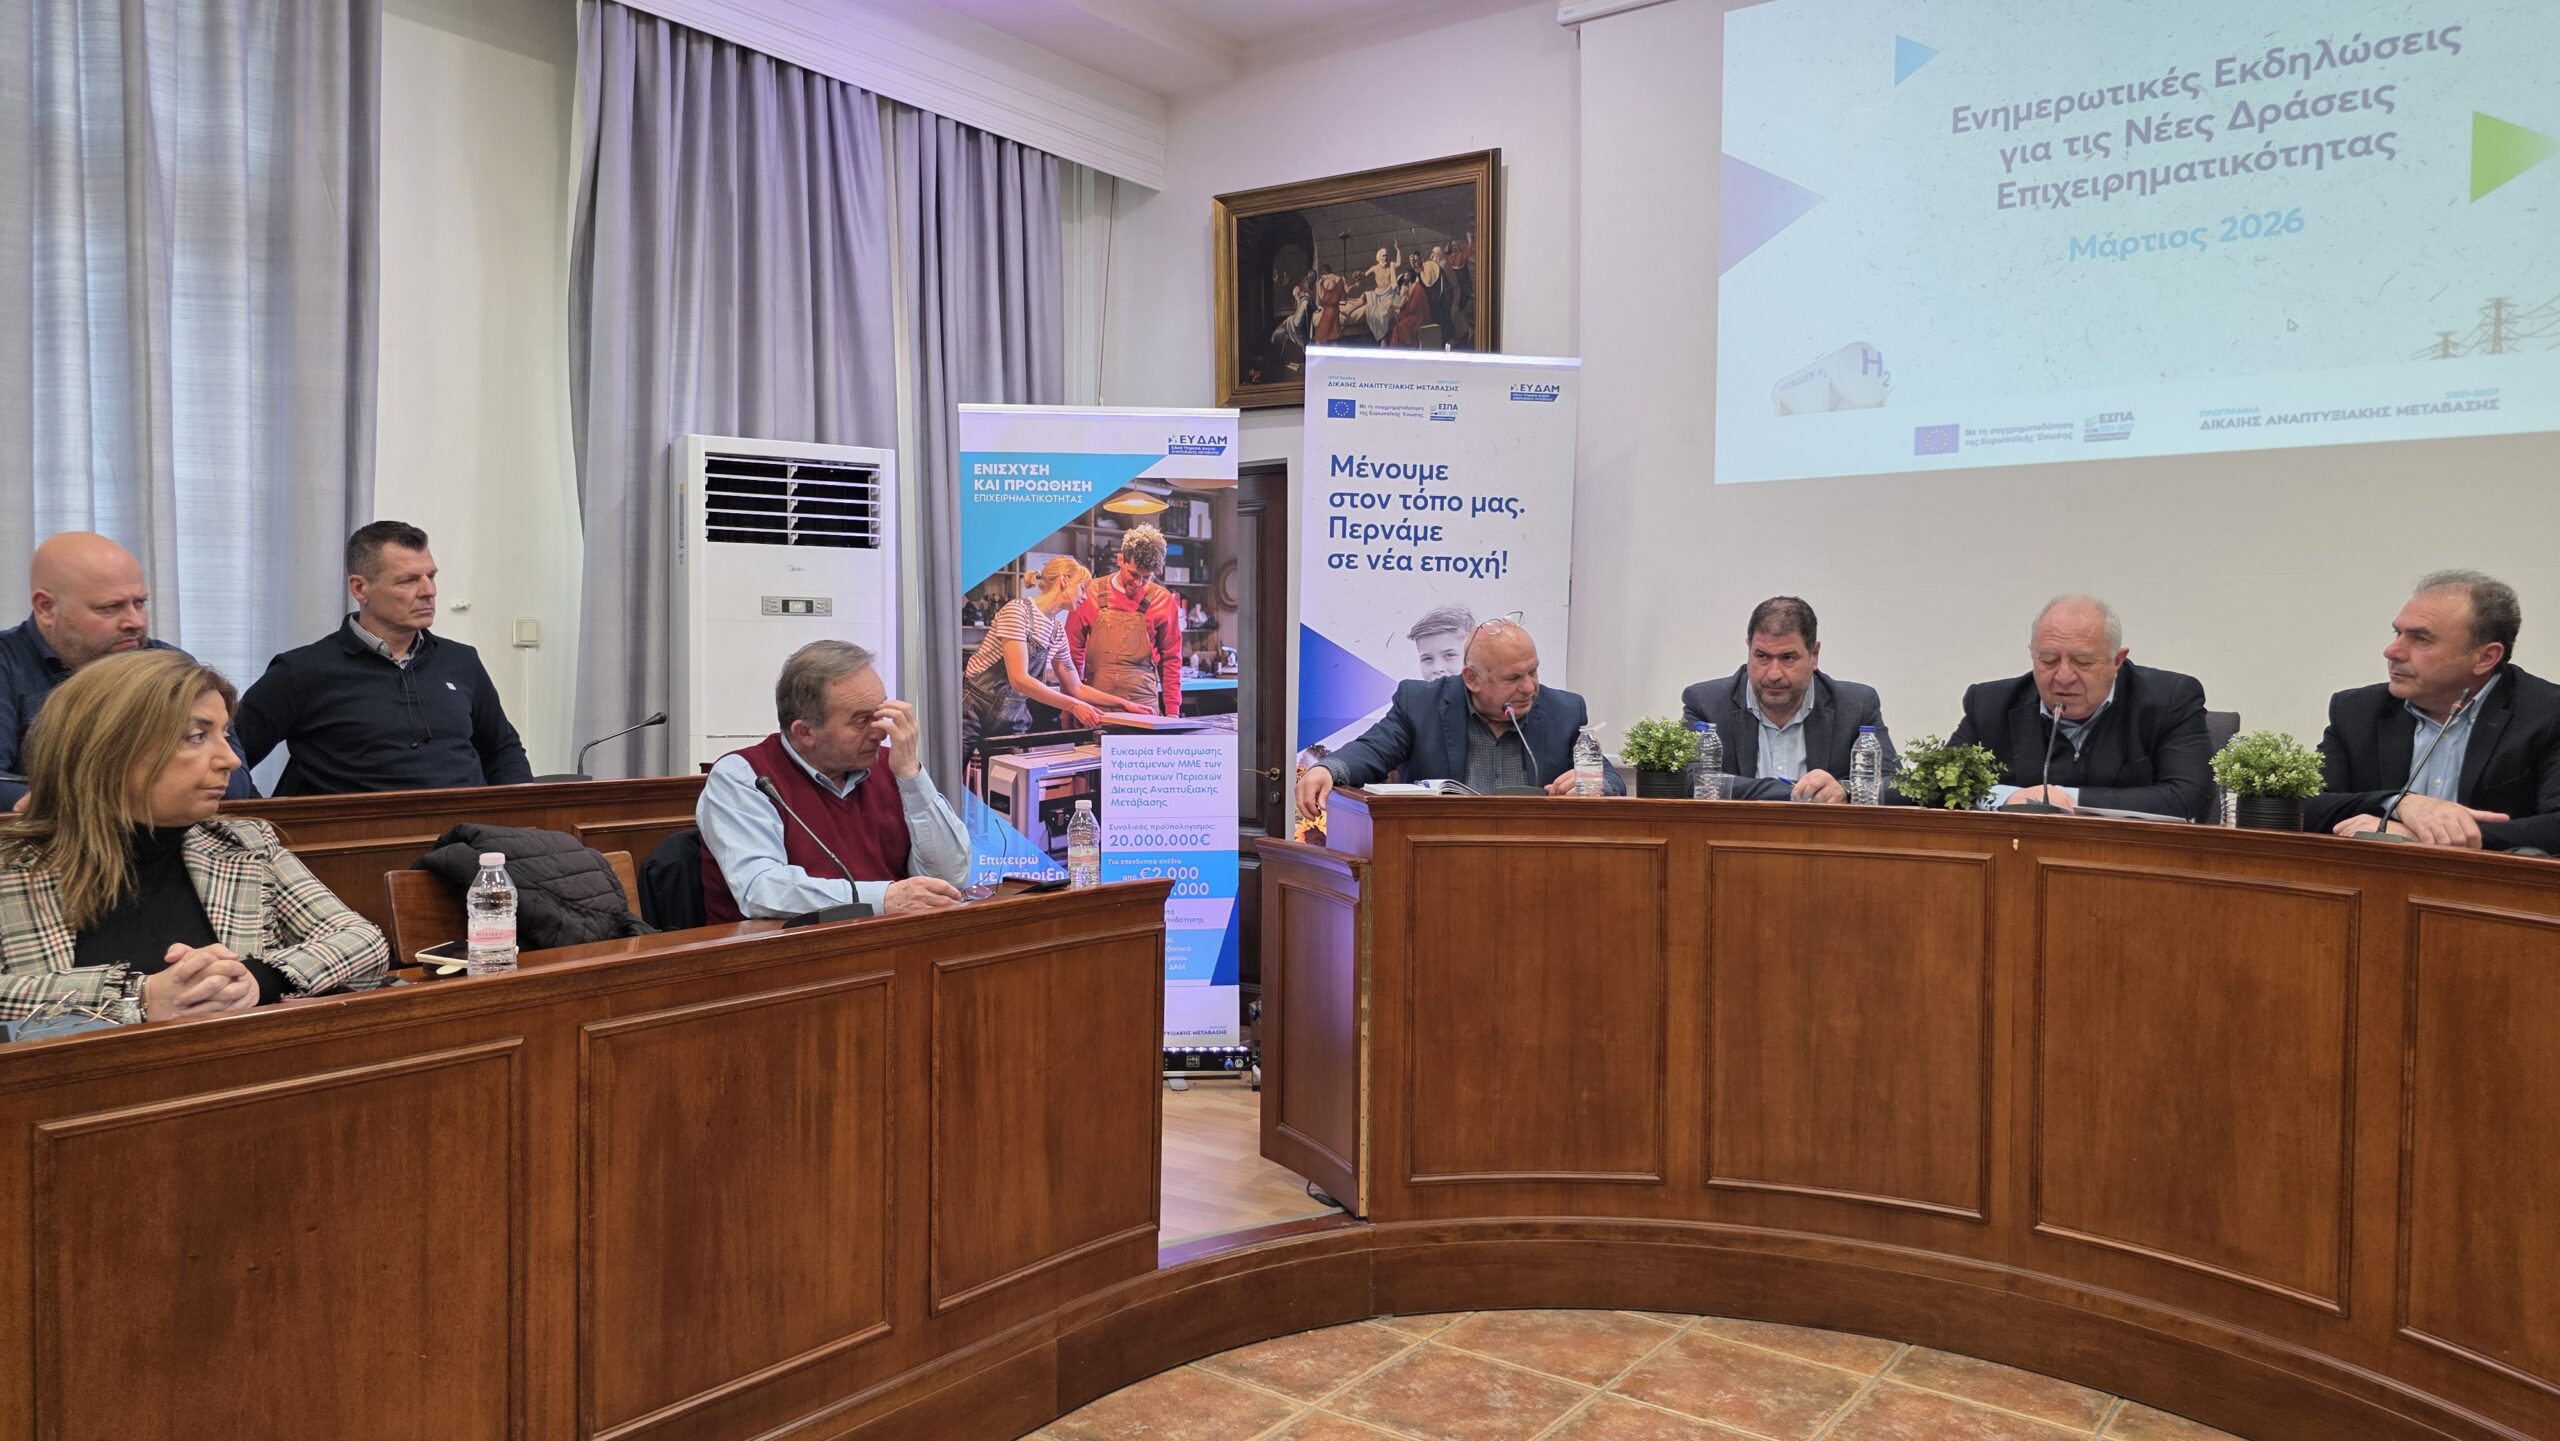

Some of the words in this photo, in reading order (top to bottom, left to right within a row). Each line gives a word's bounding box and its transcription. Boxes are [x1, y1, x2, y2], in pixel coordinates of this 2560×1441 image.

[1952, 65, 2201, 134] Ενημερωτικές
[2214, 25, 2463, 89] Εκδηλώσεις
[1998, 141, 2053, 174] για
[2062, 131, 2113, 159] τις
[2125, 111, 2215, 148] Νέες
[2227, 84, 2397, 134] Δράσεις
[1997, 131, 2398, 210] Επιχειρηματικότητας
[2069, 227, 2209, 262] Μάρτιος
[2218, 207, 2306, 243] 2026
[1358, 382, 1415, 391] ΑΝΑΠΤΥΞΙΑΚΗΣ
[1416, 384, 1460, 392] ΜΕΤΑΒΑΣΗΣ
[2099, 410, 2135, 424] ΕΣΠΑ
[2199, 415, 2262, 431] ΔΙΚΑΙΗΣ
[2265, 405, 2392, 426] ΑΝΑΠΤΥΞΙΑΚΗΣ
[2395, 398, 2500, 417] ΜΕΤΑΒΑΣΗΣ
[973, 463, 1050, 476] ΕΝΙΣΧΥΣΗ
[1330, 454, 1449, 486] Μένουμε
[973, 479, 1000, 491] ΚΑΙ
[1004, 479, 1092, 493] ΠΡΟΩΘΗΣΗ
[974, 493, 1084, 504] ΕΠΙΧΕΙΡΗΜΑΤΙΚΟΤΗΤΑΣ
[1328, 490, 1392, 509] στον
[1399, 487, 1463, 512] τόπο
[1470, 494, 1526, 520] μας.
[1328, 515, 1443, 547] Περνάμε
[1327, 551, 1359, 570] σε
[1366, 547, 1413, 571] νέα
[1420, 550, 1508, 580] εποχή!
[1110, 747, 1154, 758] Ευκαιρία
[1110, 759, 1175, 771] Υφιστάμενων
[1177, 759, 1202, 768] ΜΜΕ
[1204, 760, 1222, 768] των
[1110, 773, 1174, 784] Ηπειρωτικών
[1176, 772, 1223, 783] Περιοχών
[1110, 785, 1148, 796] Δίκαιης
[1150, 784, 1219, 795] Αναπτυξιακής
[1110, 797, 1168, 809] Μετάβασης
[1108, 823, 1149, 831] Συνολικός
[1109, 833, 1211, 847] 20.000.000€
[978, 853, 1039, 868] Επιχειρώ
